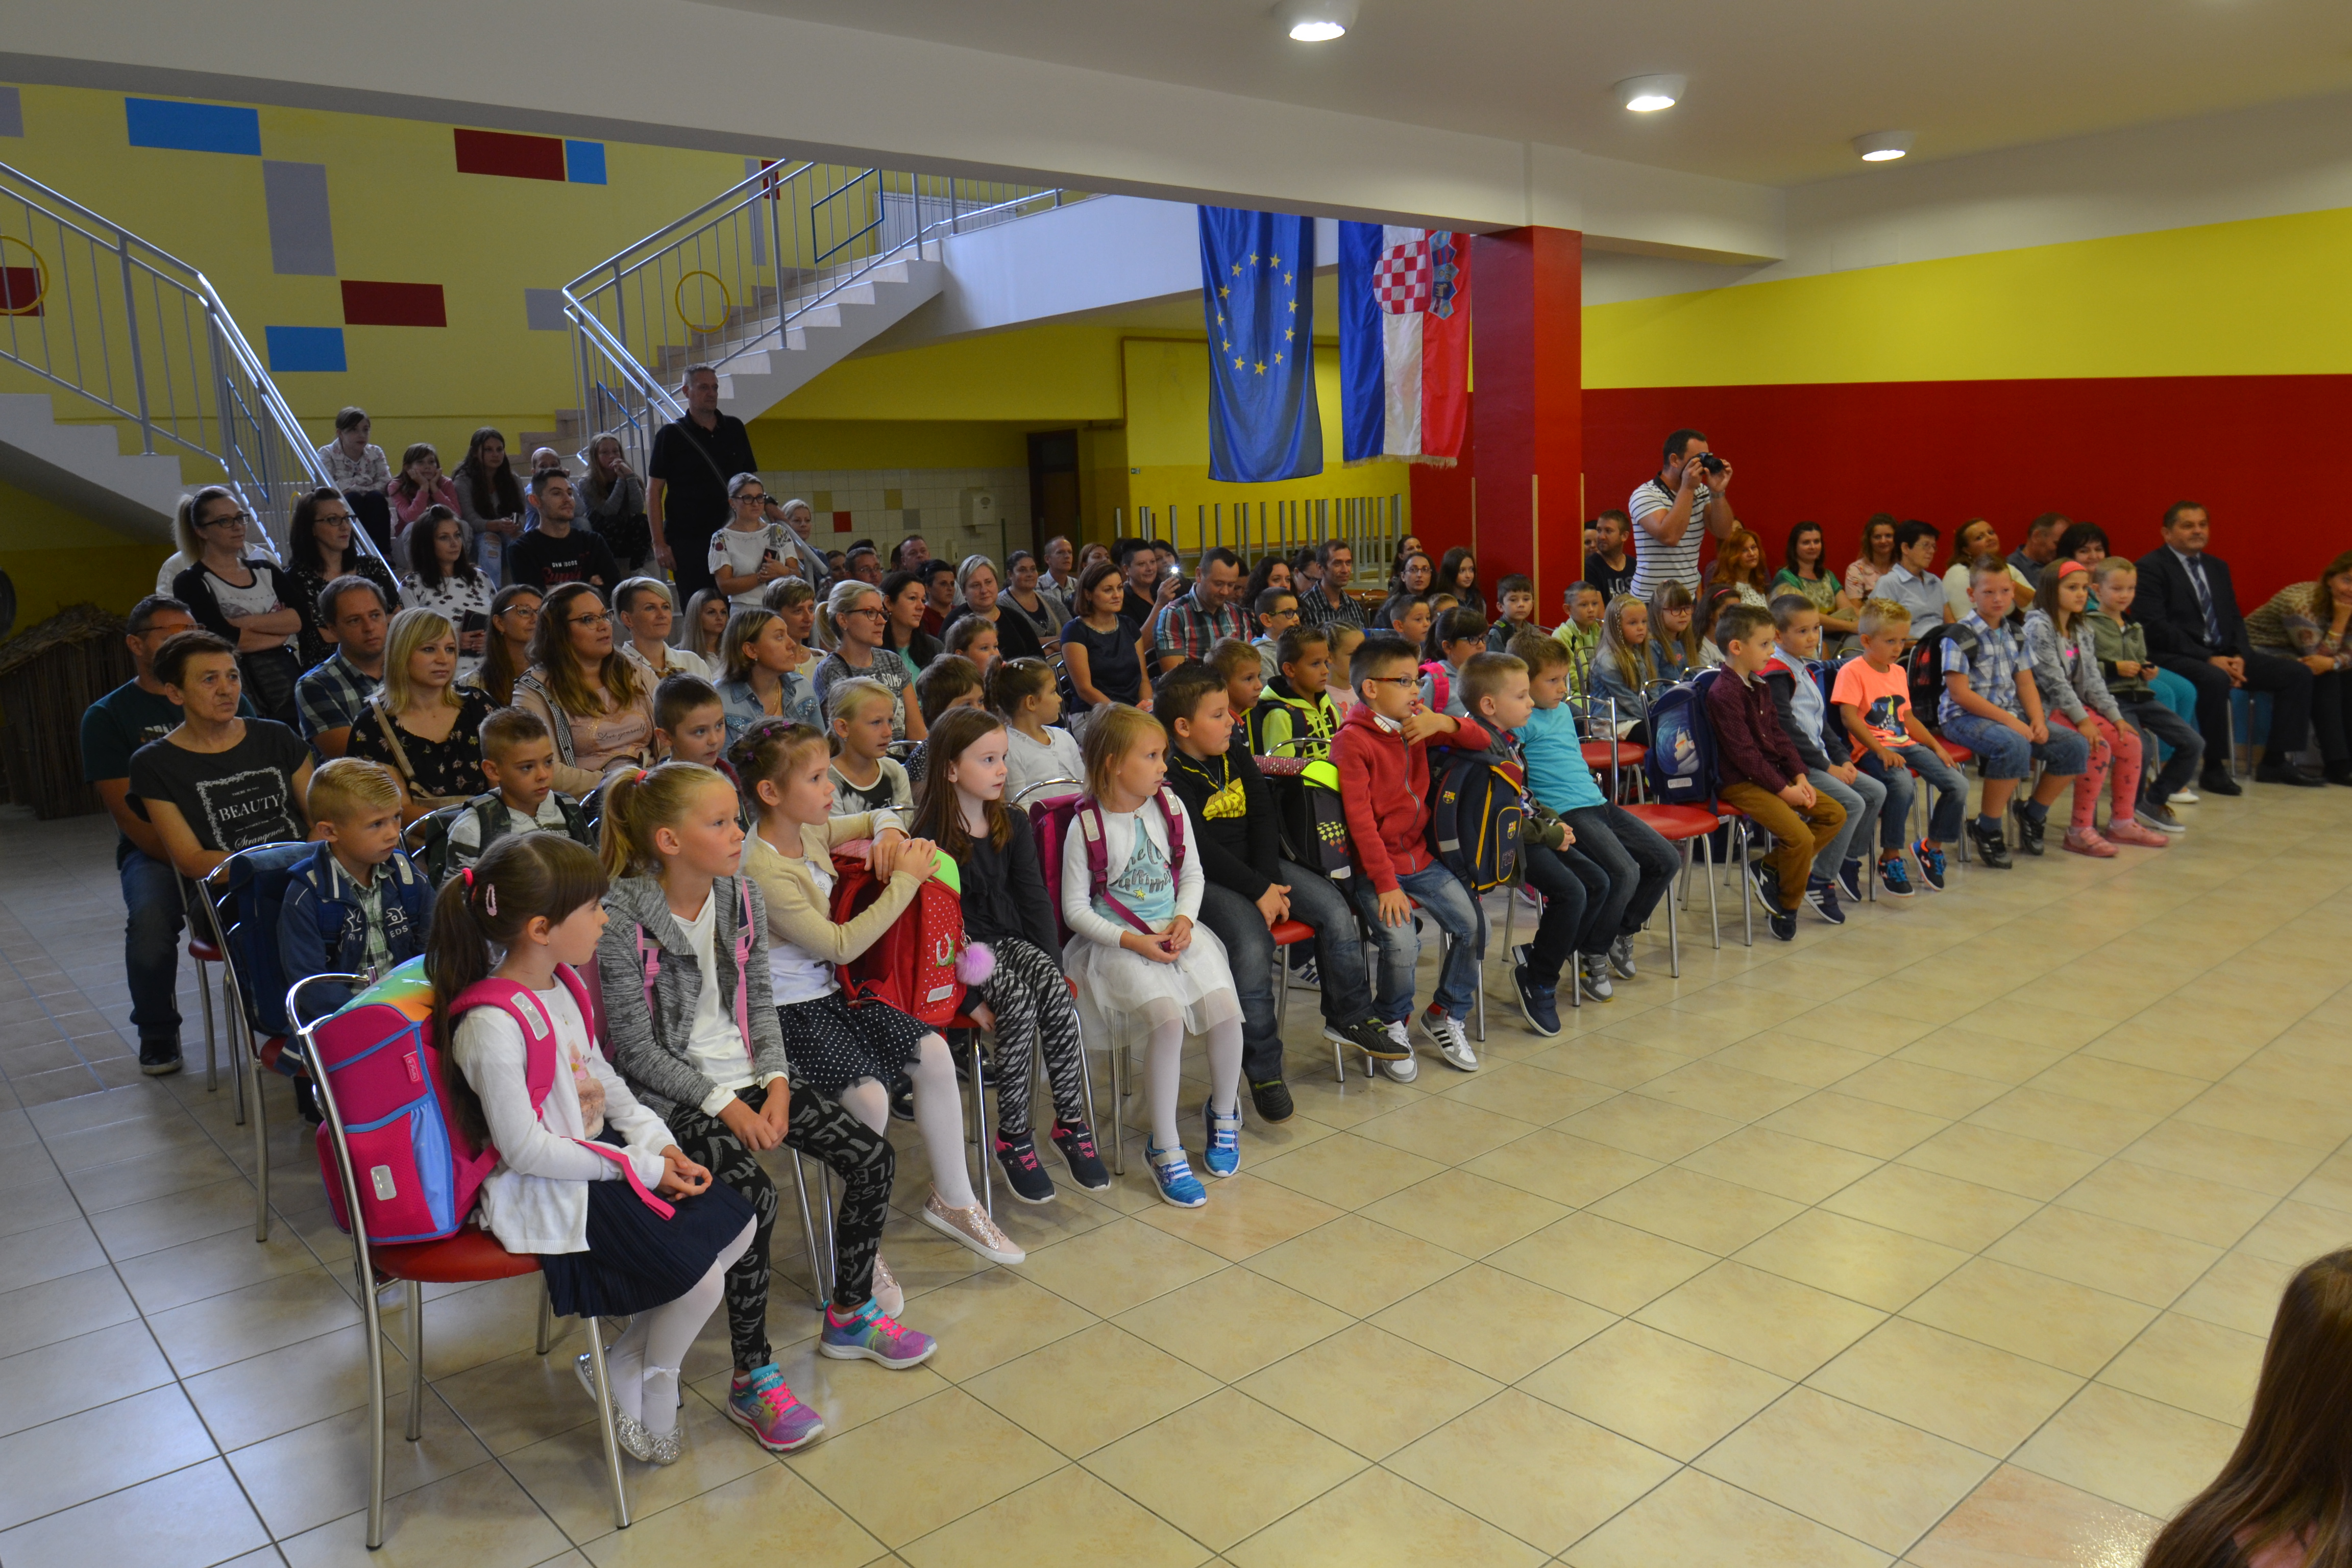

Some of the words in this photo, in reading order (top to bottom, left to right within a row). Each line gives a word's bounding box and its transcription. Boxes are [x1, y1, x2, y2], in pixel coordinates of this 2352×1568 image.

[596, 732, 616, 741] Love
[618, 723, 646, 741] yourself
[218, 794, 280, 822] BEAUTY
[234, 825, 285, 850] Strangeness
